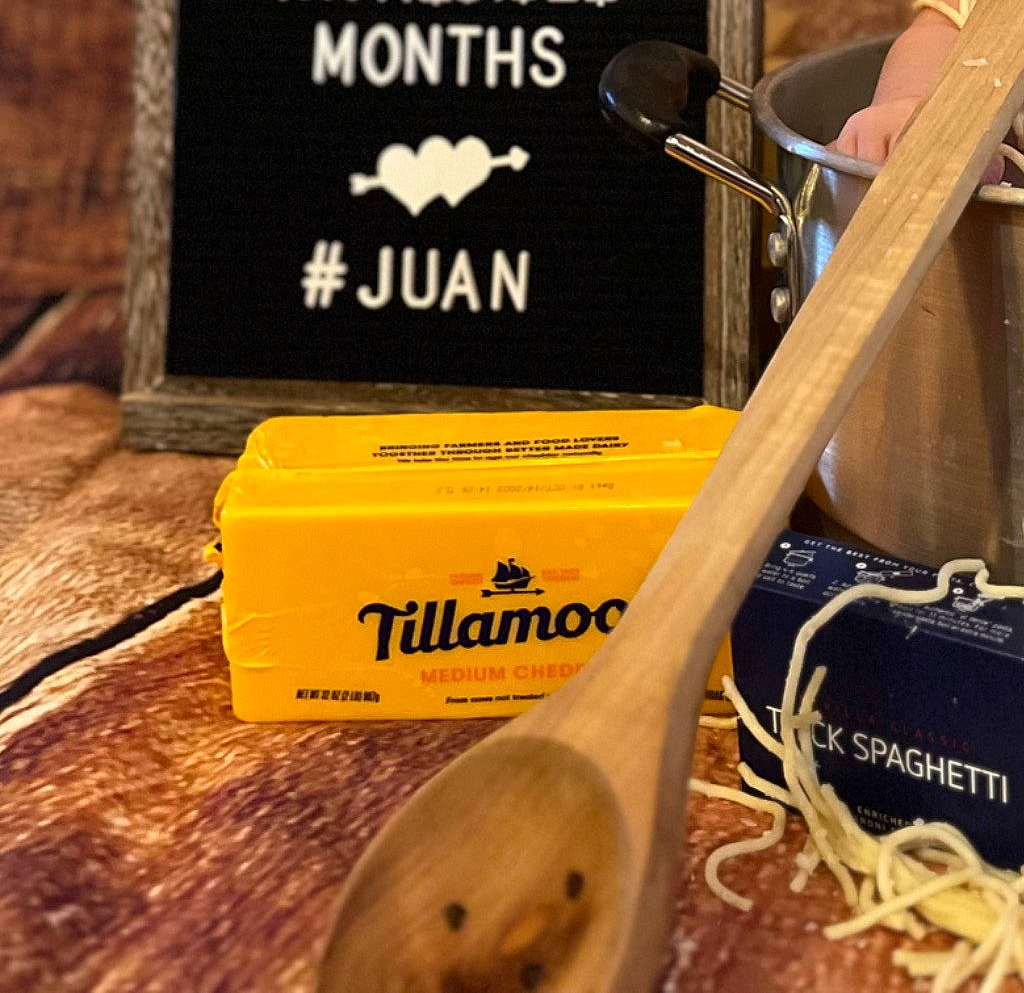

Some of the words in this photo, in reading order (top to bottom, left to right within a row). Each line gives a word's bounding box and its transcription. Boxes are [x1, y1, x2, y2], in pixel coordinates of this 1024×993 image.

[311, 21, 567, 89] MONTHS
[300, 239, 531, 314] #JUAN
[371, 450, 436, 458] TOGETHER
[592, 441, 630, 450] DAIRY
[533, 437, 571, 445] FOOD
[573, 435, 620, 443] LOVERS
[803, 539, 823, 547] GET
[825, 544, 844, 553] THE
[845, 549, 870, 560] BEST
[873, 556, 900, 568] FROM
[358, 598, 630, 662] Tillamoo
[420, 667, 507, 685] MEDIUM
[512, 662, 587, 681] CHED
[494, 694, 511, 703] not
[766, 705, 846, 755] TCK
[853, 731, 1008, 805] SPAGHETTI
